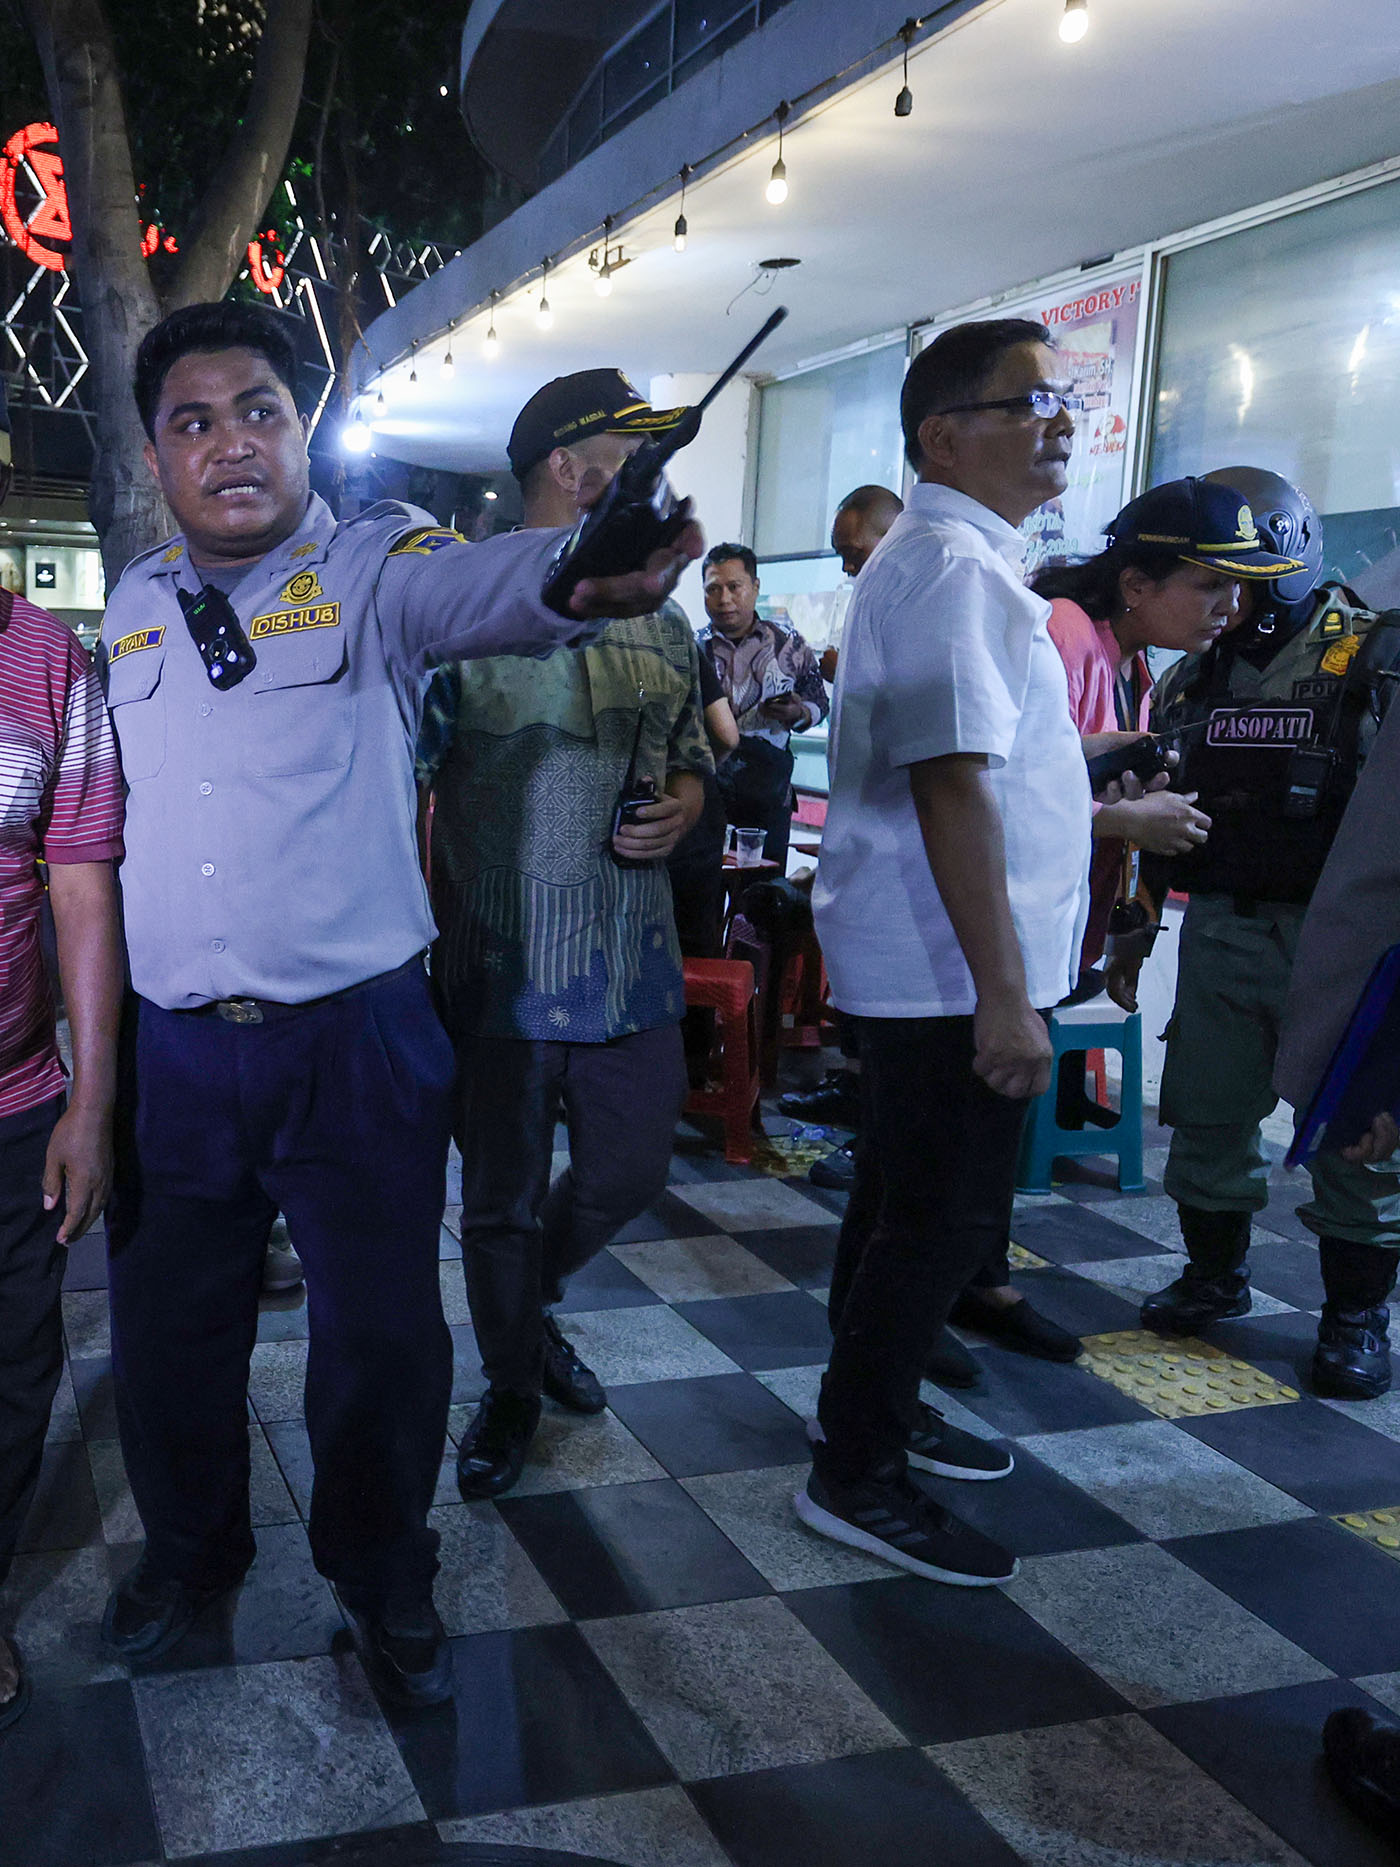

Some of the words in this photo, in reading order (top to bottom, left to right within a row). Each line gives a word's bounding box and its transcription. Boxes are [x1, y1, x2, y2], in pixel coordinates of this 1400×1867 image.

[1041, 286, 1126, 327] VICTORY
[256, 606, 335, 634] DISHUB
[118, 632, 149, 654] RYAN
[1212, 716, 1308, 739] PASOPATI
